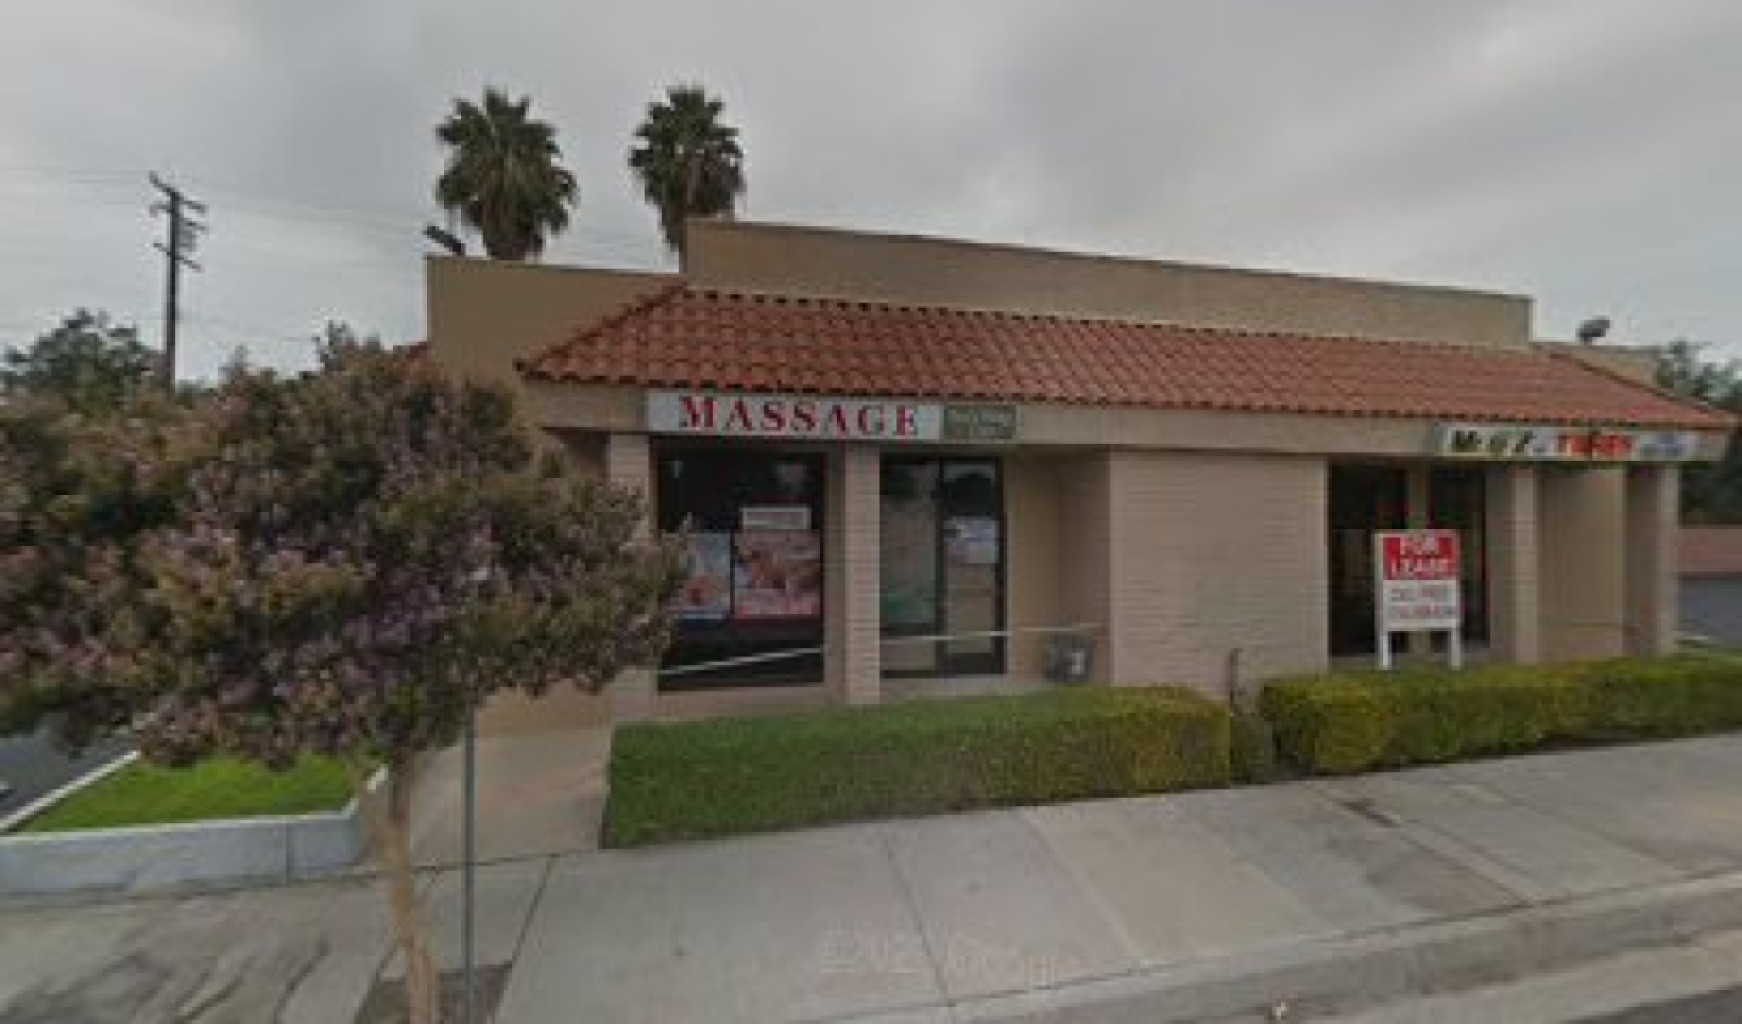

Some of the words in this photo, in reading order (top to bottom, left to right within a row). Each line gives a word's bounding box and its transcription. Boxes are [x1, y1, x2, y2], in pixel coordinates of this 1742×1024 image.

[678, 395, 920, 437] MASSAGE
[1399, 533, 1440, 556] FOR
[1390, 557, 1455, 580] LEASE
